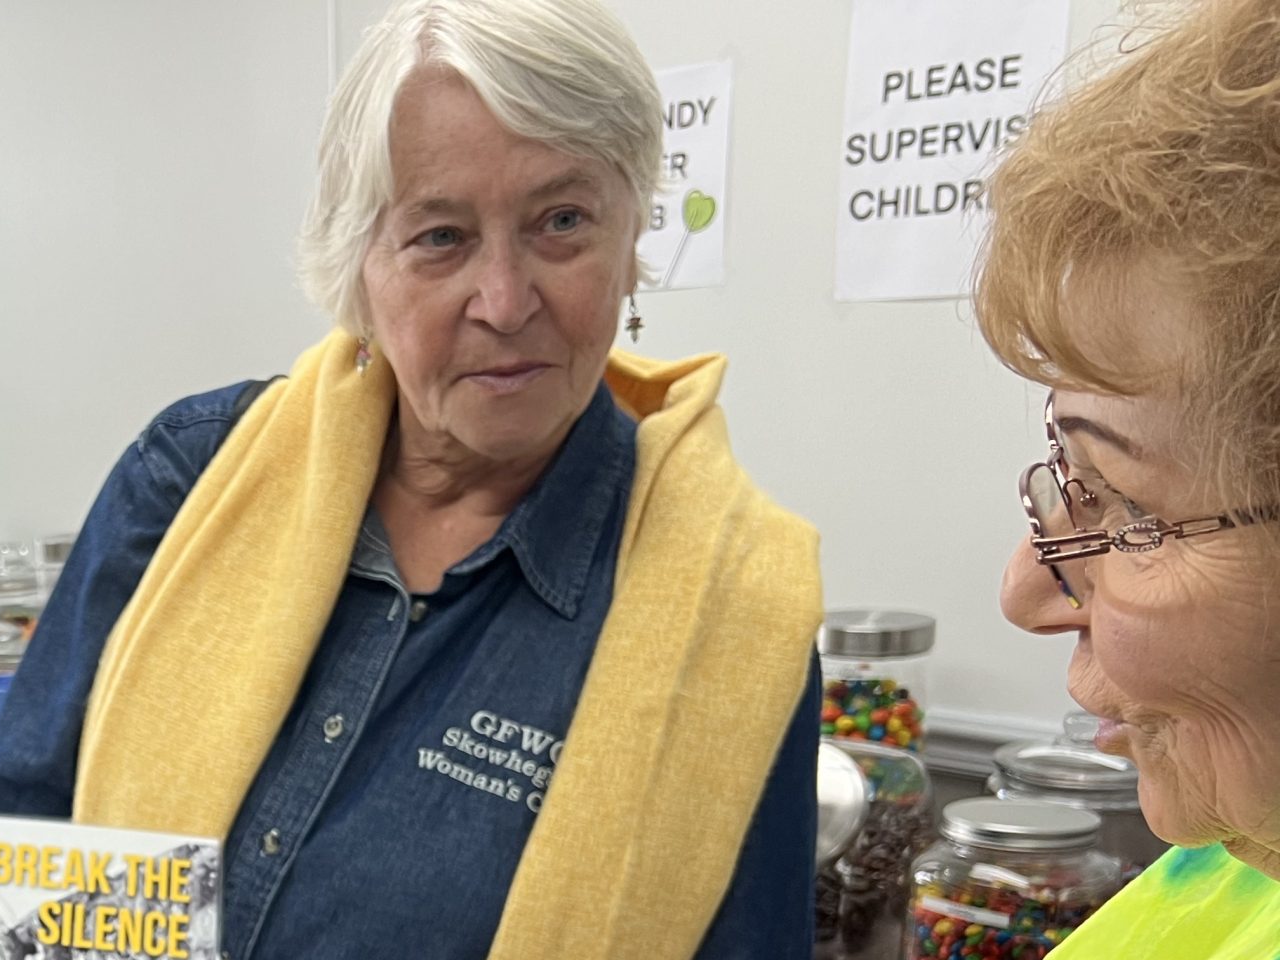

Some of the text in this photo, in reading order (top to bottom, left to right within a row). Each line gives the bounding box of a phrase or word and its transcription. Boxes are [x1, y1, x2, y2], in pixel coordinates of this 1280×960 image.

[881, 54, 1022, 103] PLEASE
[661, 96, 717, 130] NDY
[846, 114, 1026, 165] SUPERVIS
[849, 180, 984, 222] CHILDR
[418, 748, 523, 802] Woman's
[442, 726, 554, 788] Skowheg
[123, 855, 192, 904] THE
[37, 901, 189, 959] SILENCE
